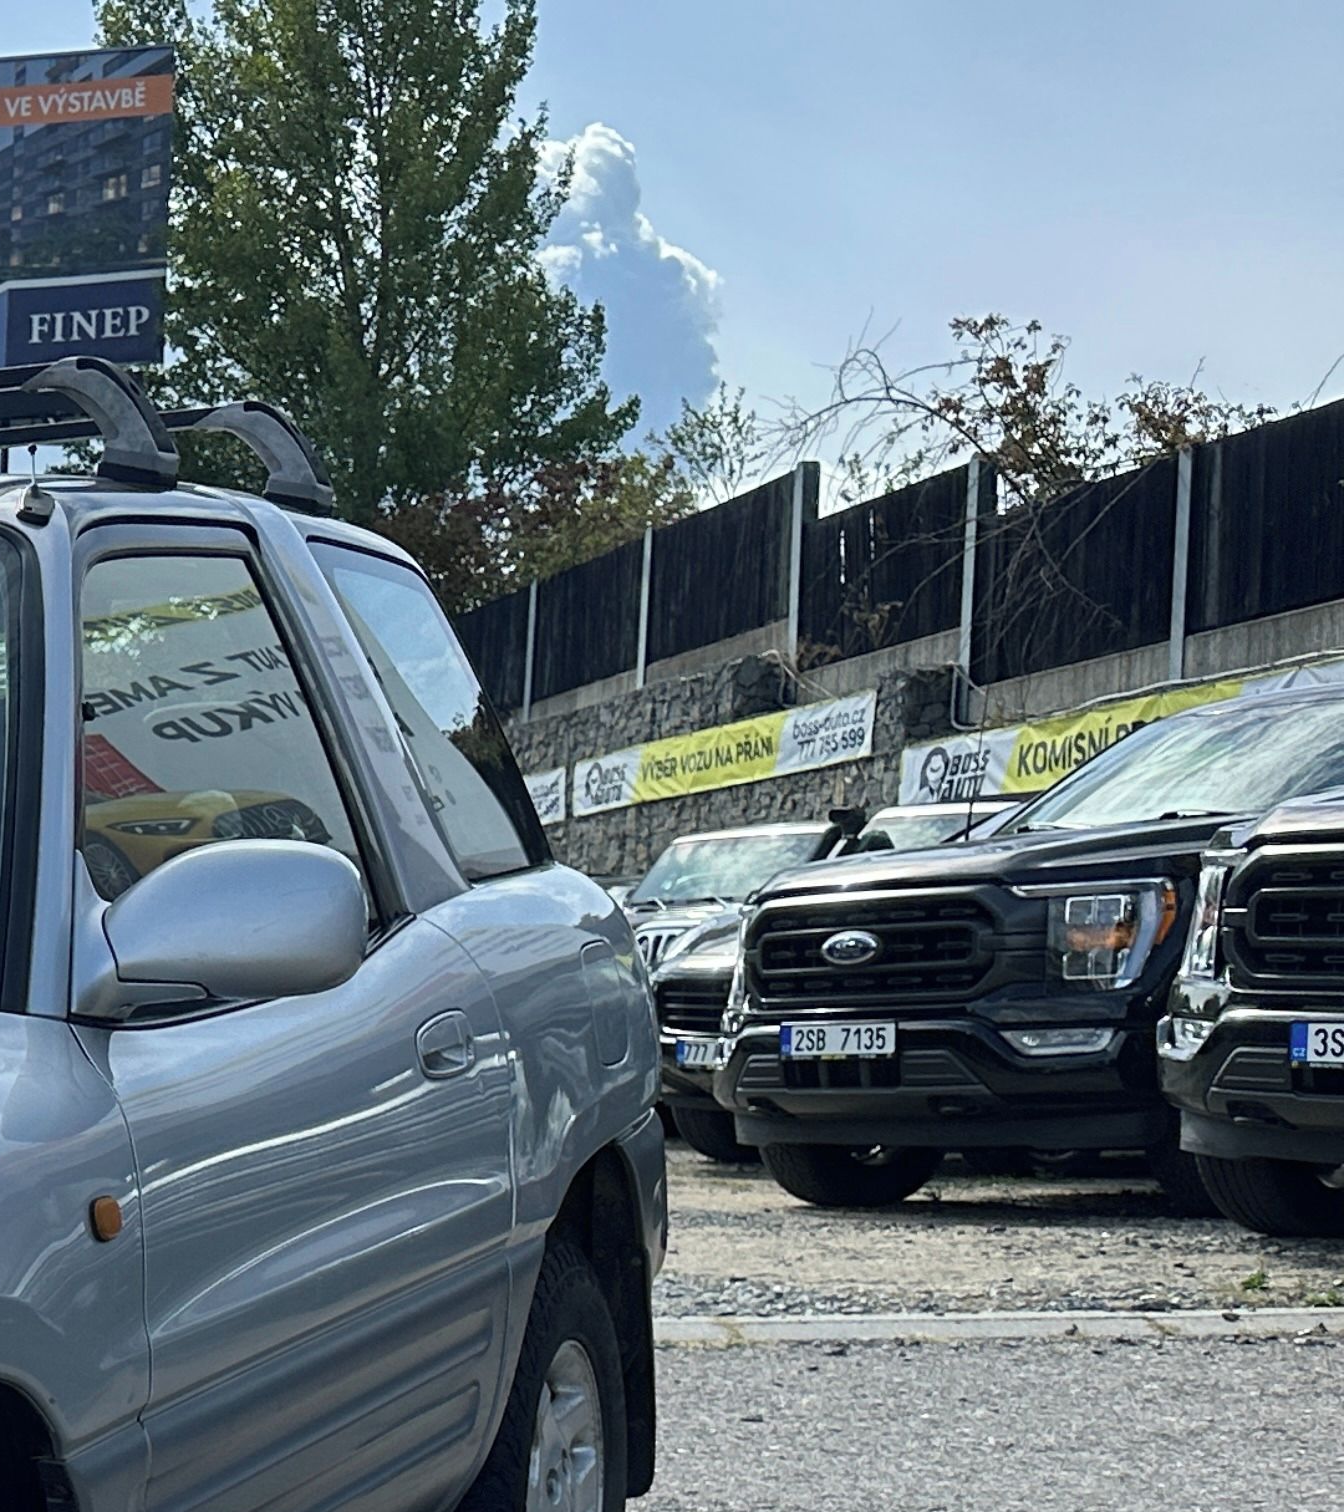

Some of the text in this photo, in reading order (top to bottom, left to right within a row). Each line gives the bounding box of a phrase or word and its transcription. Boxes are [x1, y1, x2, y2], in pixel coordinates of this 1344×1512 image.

[4, 96, 33, 118] VE
[37, 80, 147, 116] VÝSTAVBĚ
[27, 305, 151, 345] FINEP
[841, 726, 865, 750] 599
[1017, 716, 1113, 777] KOMISNÍ
[680, 748, 712, 775] VOZU
[715, 744, 733, 768] NA
[949, 749, 991, 776] BOSS
[685, 1043, 708, 1062] 777
[794, 1028, 826, 1052] 2SB
[840, 1027, 887, 1051] 7135
